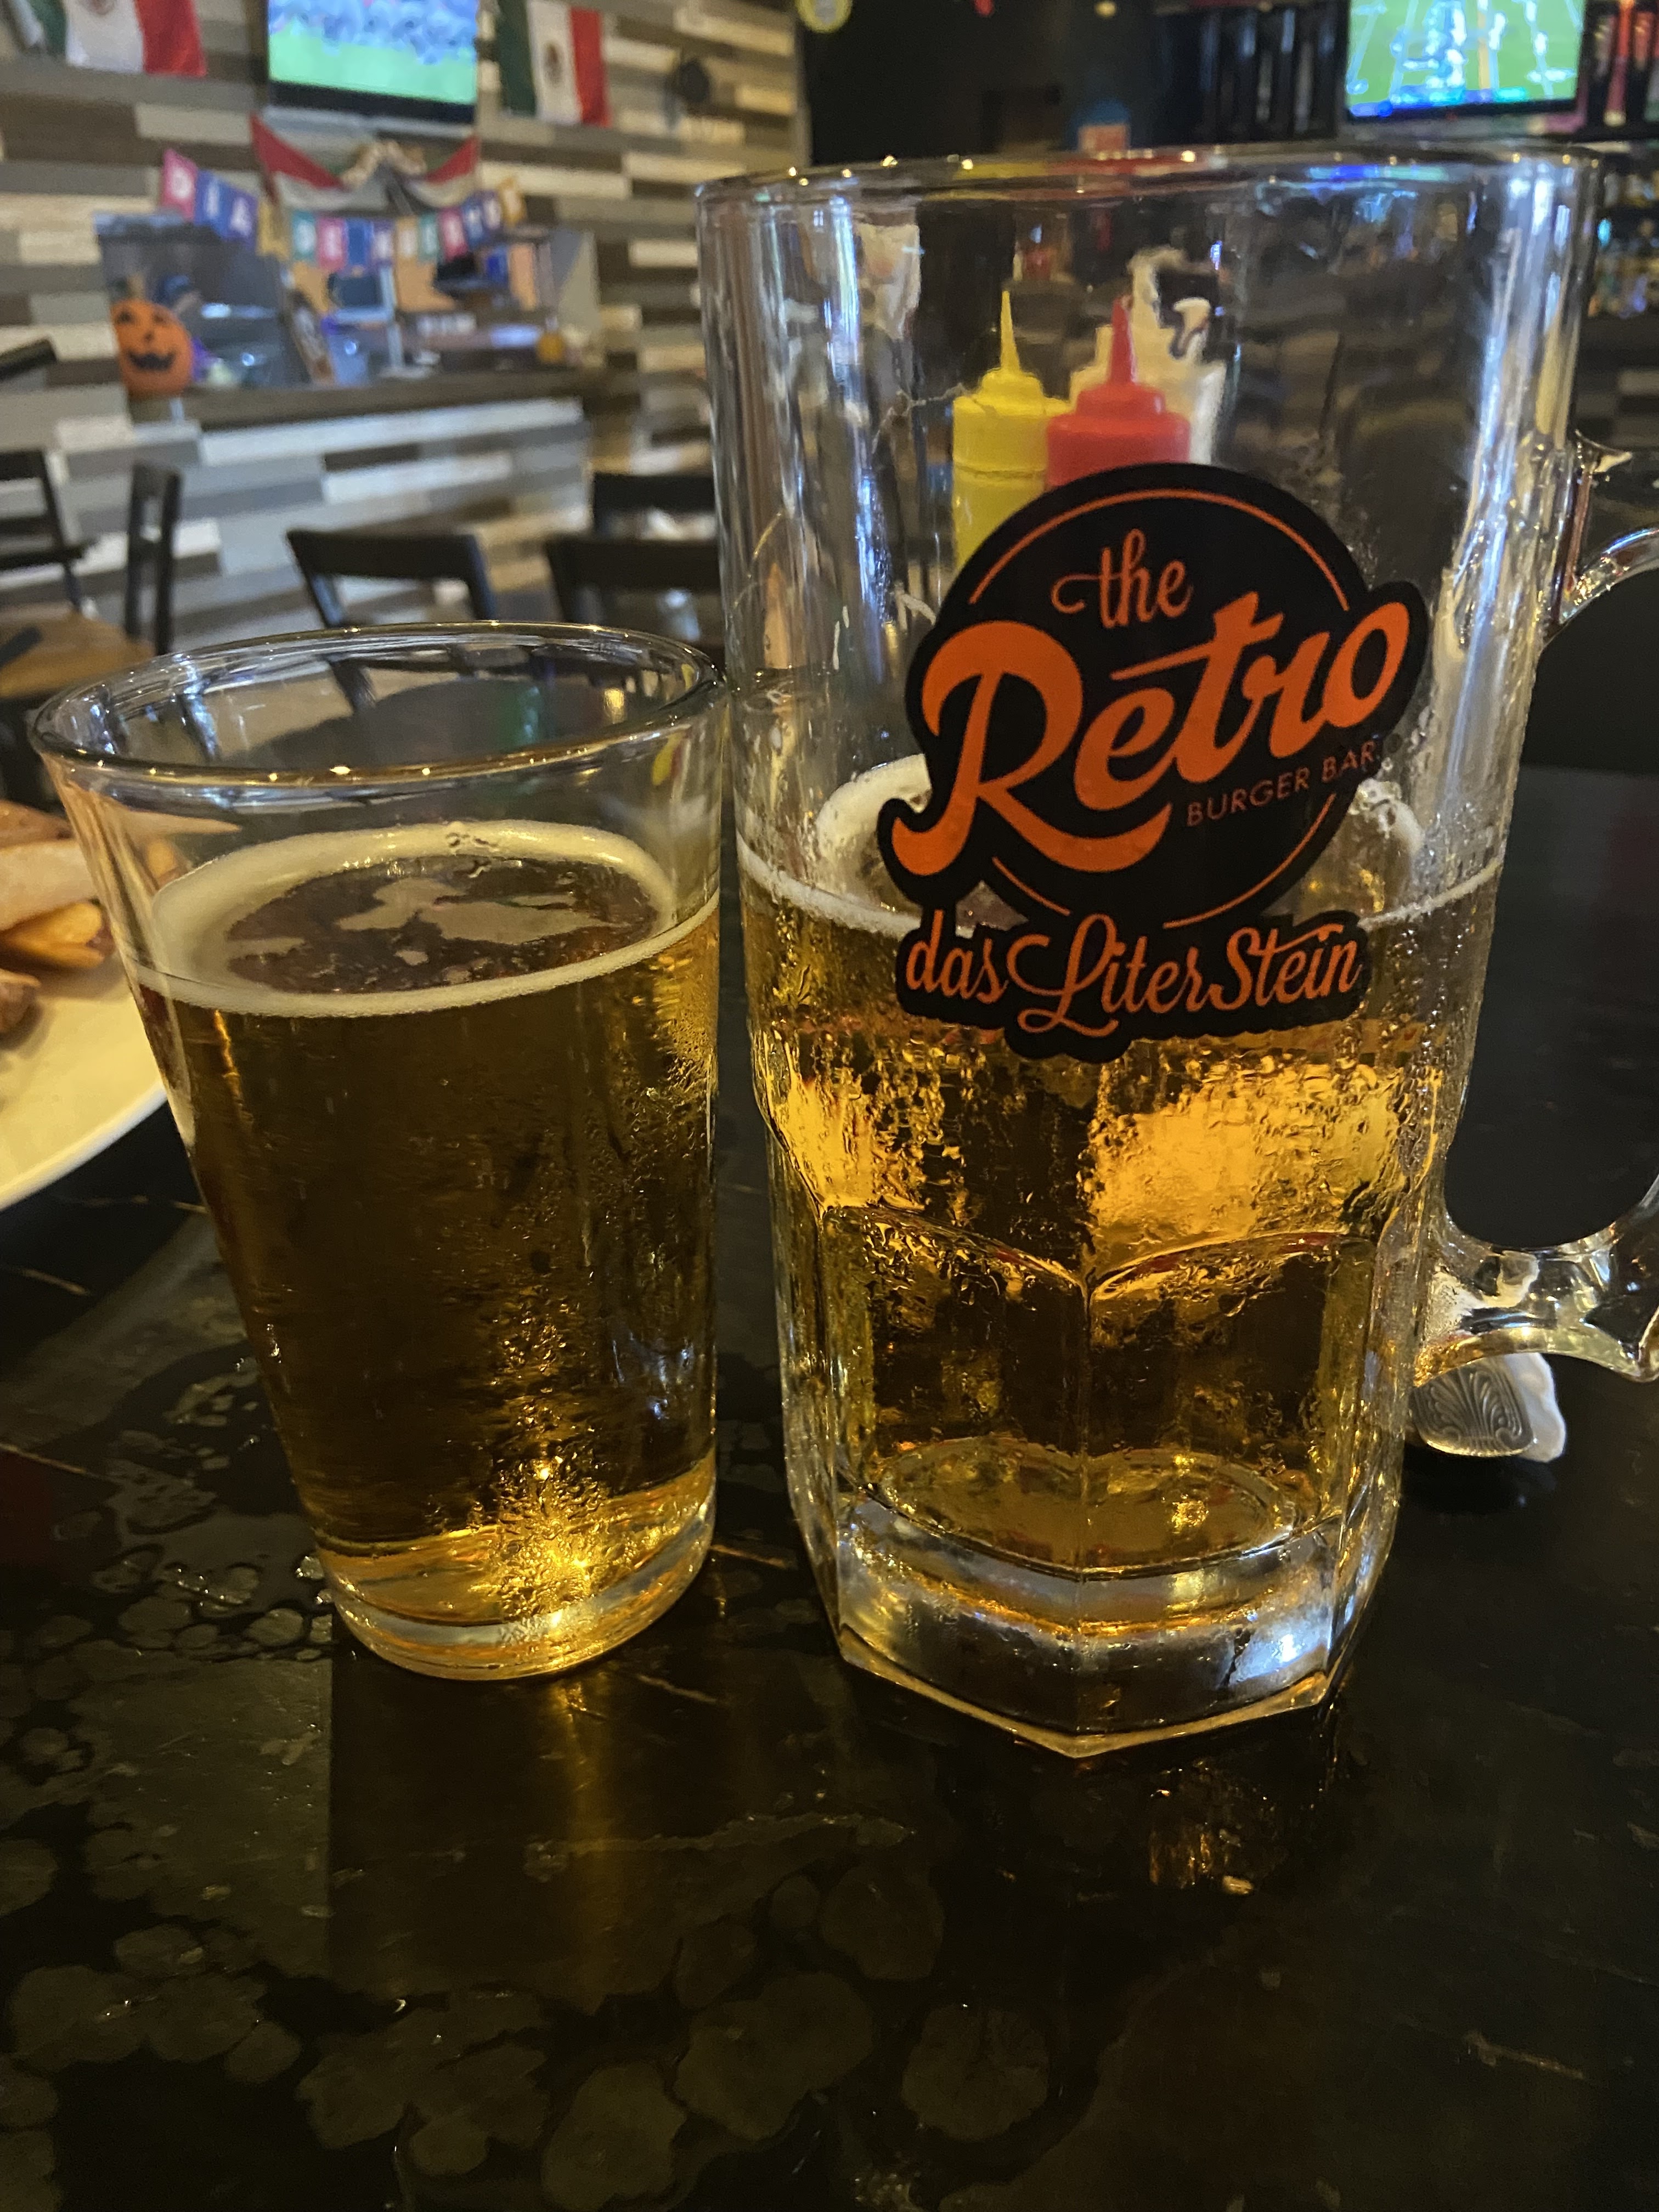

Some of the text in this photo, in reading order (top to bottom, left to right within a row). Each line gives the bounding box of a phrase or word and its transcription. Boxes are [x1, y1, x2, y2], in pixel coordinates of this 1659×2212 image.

[1051, 528, 1194, 628] the
[891, 591, 1410, 877] Retro
[1187, 740, 1376, 827] BURGER BAR
[906, 909, 1363, 1037] das Liter Stein
